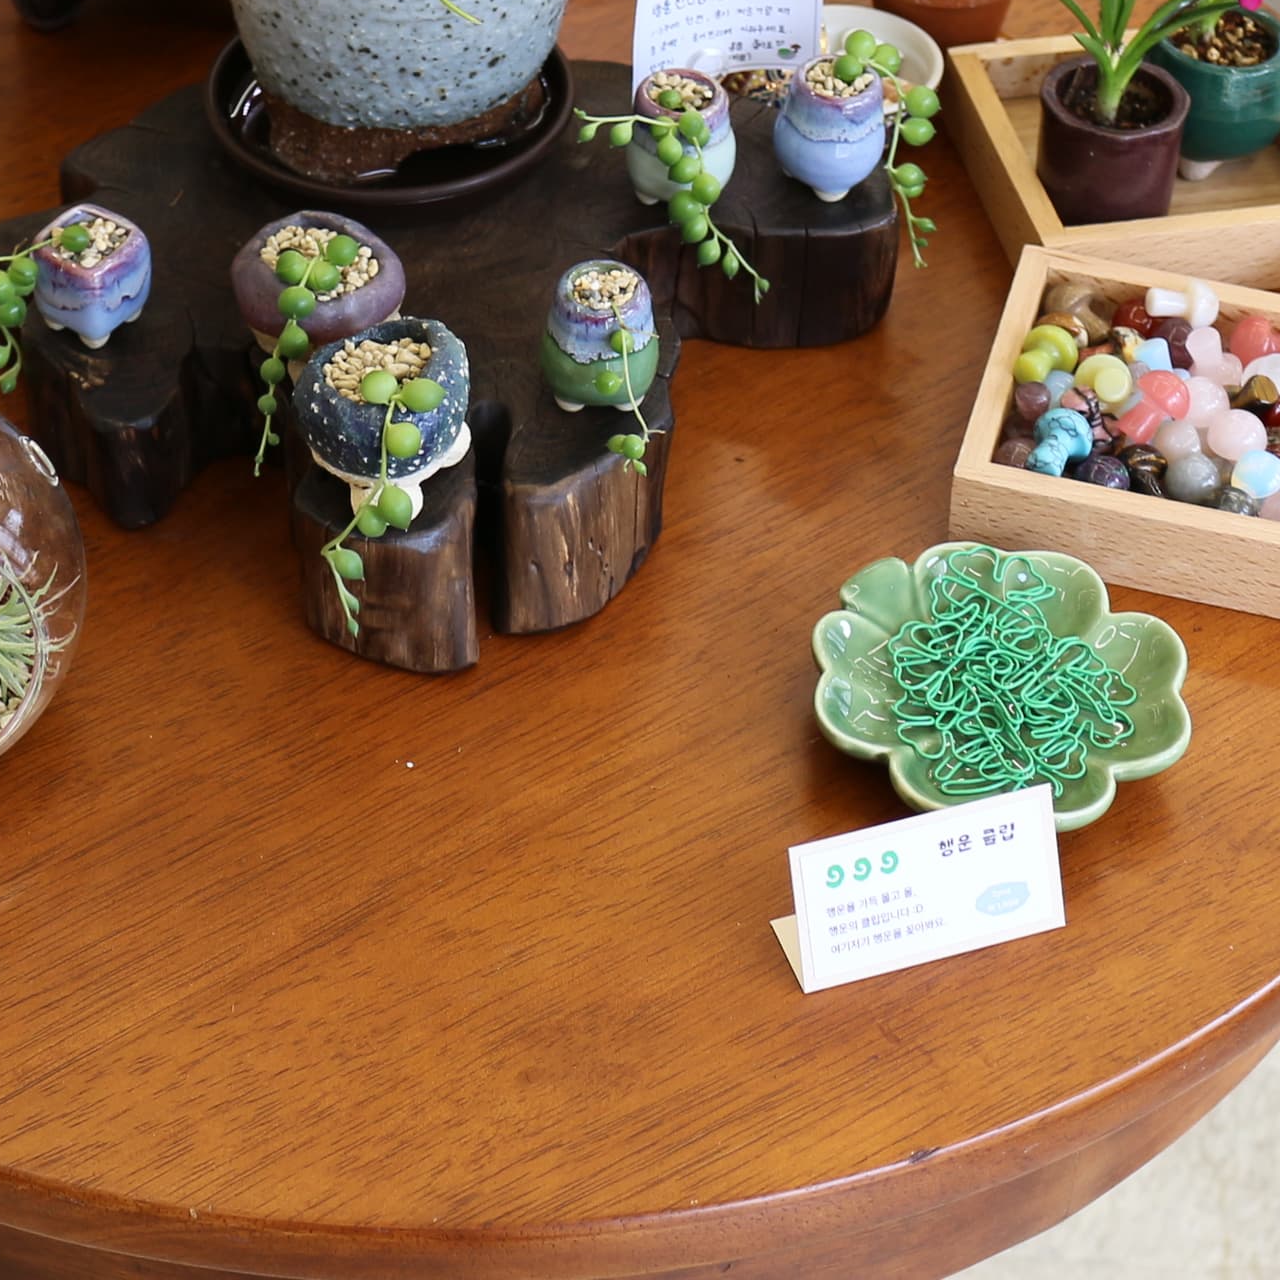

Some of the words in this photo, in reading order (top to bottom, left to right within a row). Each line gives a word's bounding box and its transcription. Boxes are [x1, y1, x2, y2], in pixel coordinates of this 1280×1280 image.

[938, 833, 972, 858] 행운
[982, 822, 1015, 847] 클립
[826, 901, 855, 918] 행운을
[828, 920, 858, 937] 행운의
[862, 906, 910, 929] 클립입니다
[831, 935, 871, 954] 여기저기
[873, 927, 902, 944] 행운을
